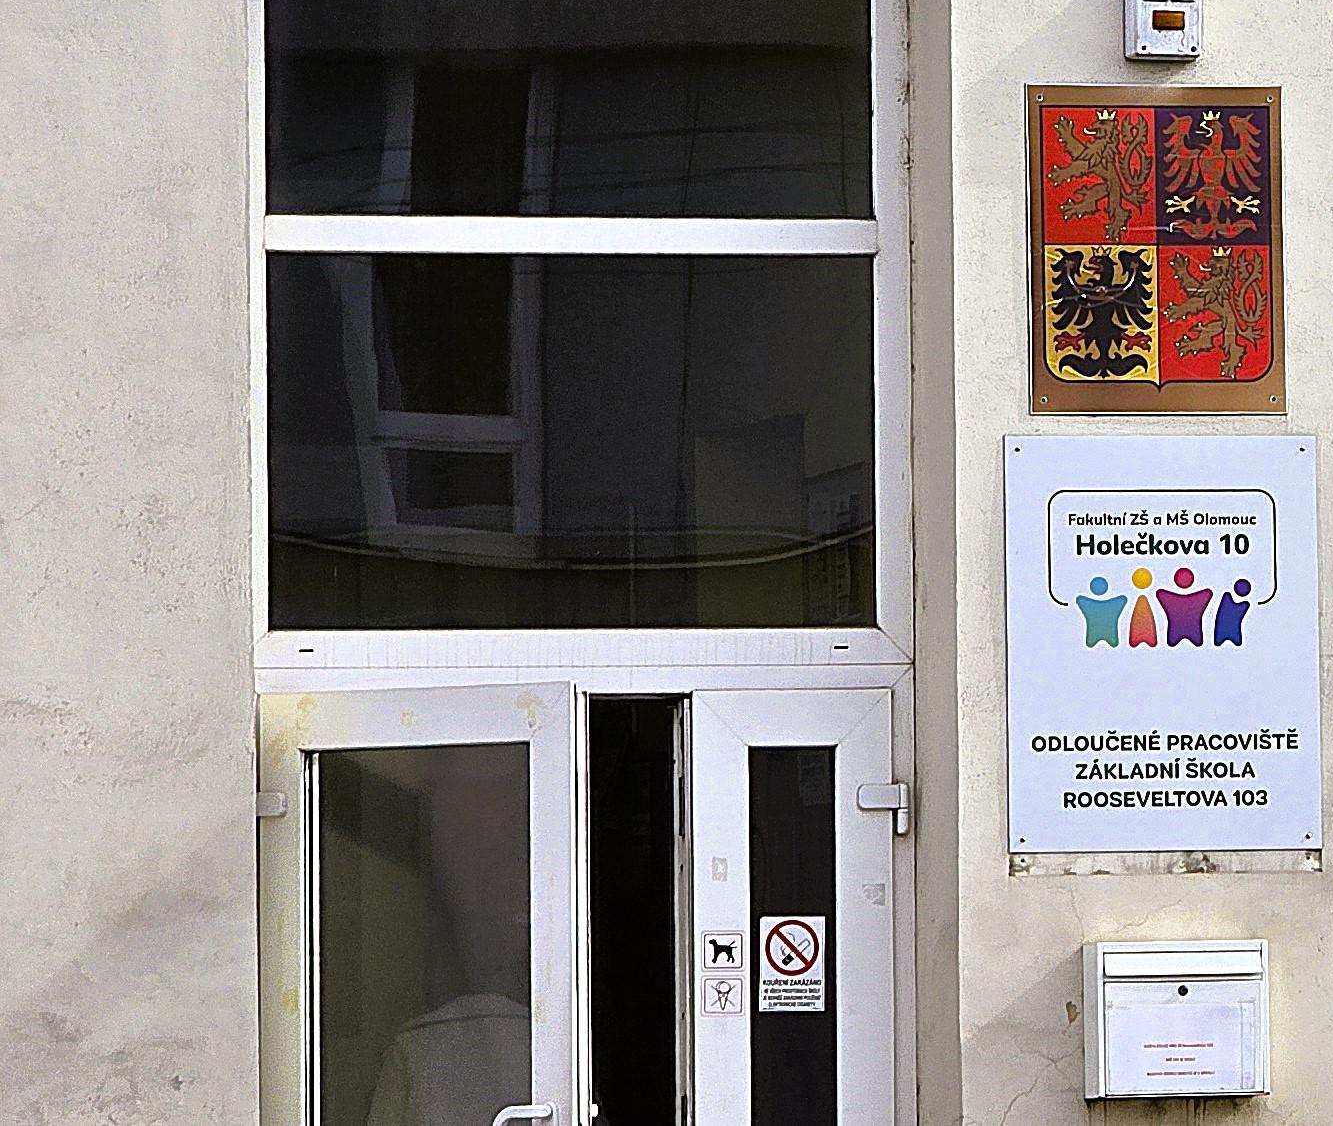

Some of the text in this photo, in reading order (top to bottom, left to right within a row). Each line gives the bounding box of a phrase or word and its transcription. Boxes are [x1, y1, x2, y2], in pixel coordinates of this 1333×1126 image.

[1068, 509, 1257, 526] Fakultní ZŠ a MŠ Olomouc
[1076, 531, 1250, 556] Holečkova 10
[1031, 728, 1299, 752] ODLOUČENÉ PRACOVIŠTĚ
[1075, 757, 1256, 780] ZÁKLADNÍ ŠKOLA
[1063, 789, 1268, 809] ROOSEVELTOVA 103
